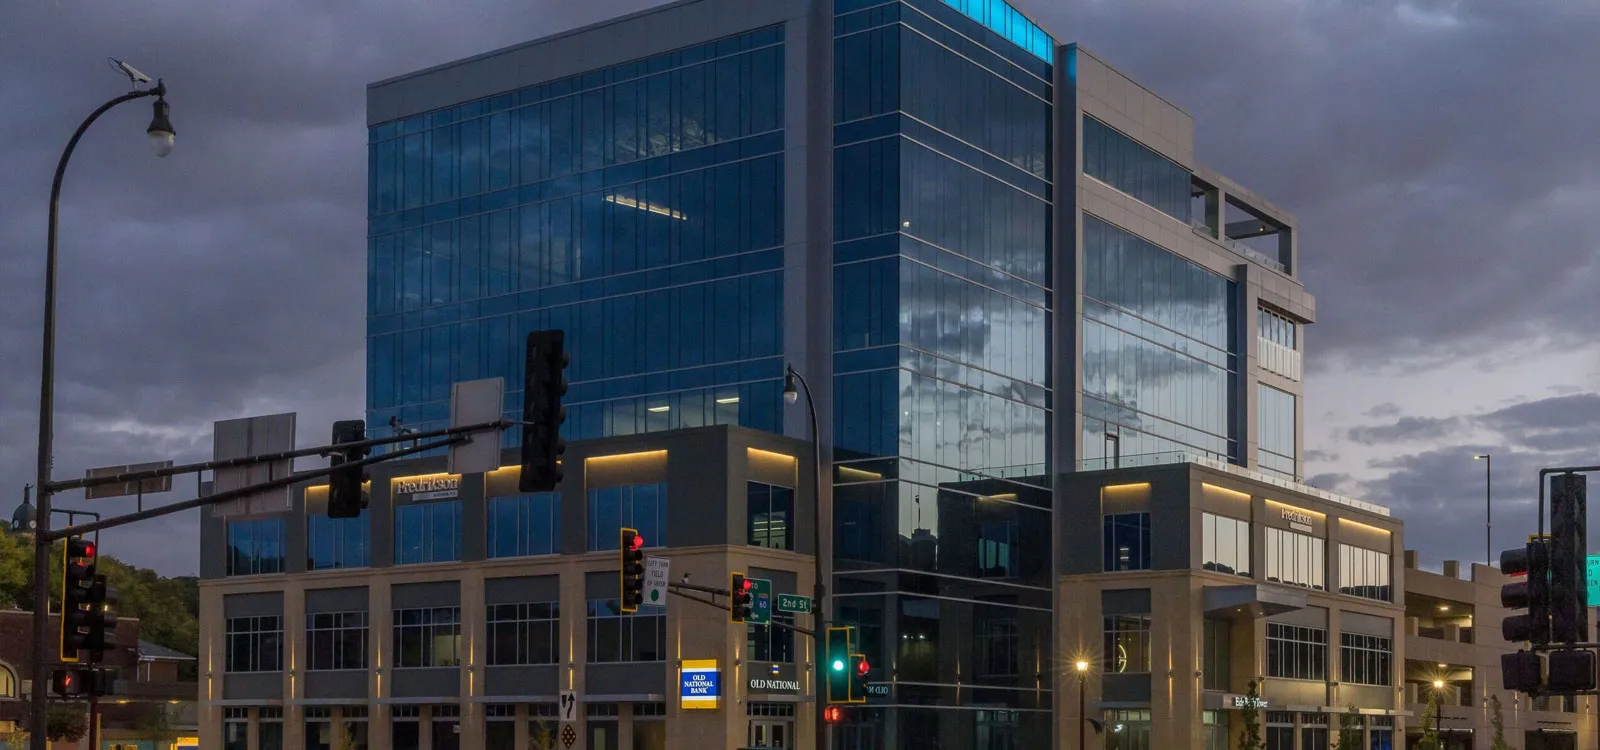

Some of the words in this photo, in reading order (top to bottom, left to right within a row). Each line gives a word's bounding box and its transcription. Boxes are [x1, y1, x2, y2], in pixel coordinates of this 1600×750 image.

[397, 478, 458, 494] Fredrikson
[751, 582, 759, 590] TO
[782, 598, 797, 608] 2nd
[799, 600, 807, 609] St
[684, 680, 714, 688] NATIONAL
[750, 679, 766, 689] OLD
[766, 680, 800, 690] NATIONAL
[690, 686, 707, 694] BANK
